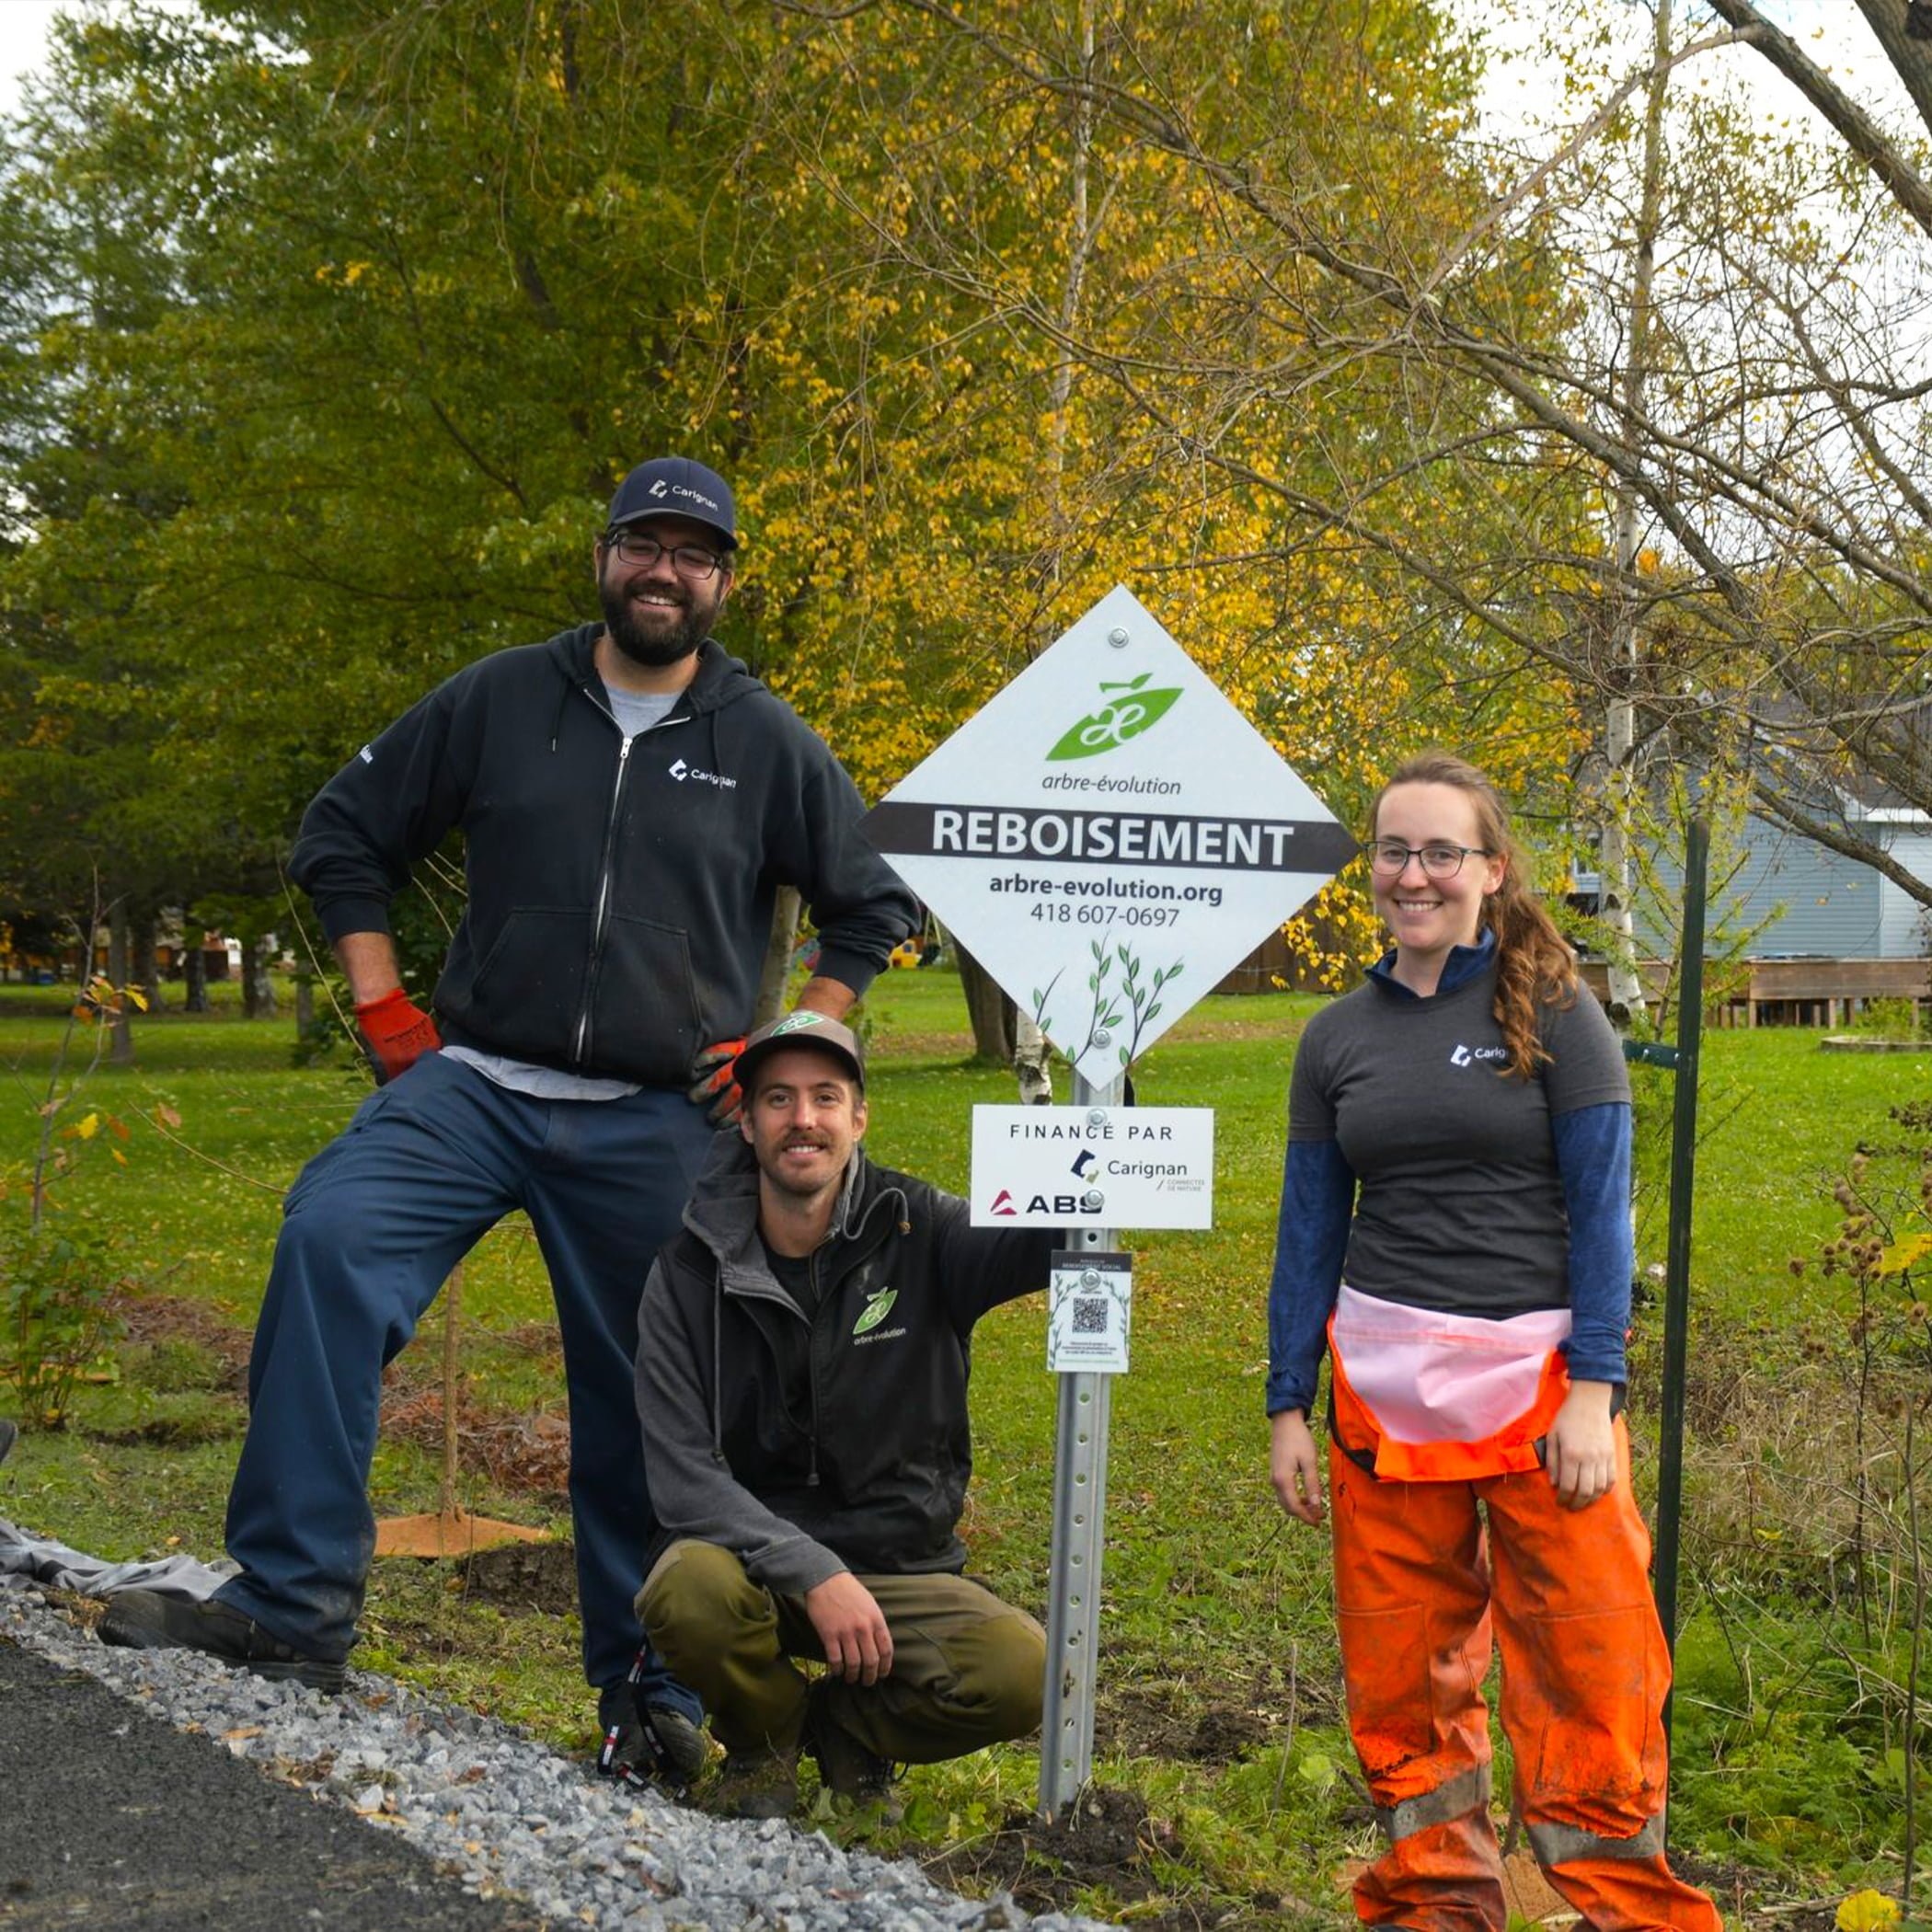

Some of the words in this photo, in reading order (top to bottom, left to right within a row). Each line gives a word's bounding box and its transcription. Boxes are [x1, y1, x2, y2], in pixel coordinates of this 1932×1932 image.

[672, 485, 719, 512] Carignan
[691, 768, 737, 789] Carignan
[1041, 773, 1181, 795] arbre-évolution
[932, 809, 1294, 867] REBOISEMENT
[989, 873, 1223, 907] arbre-evolution.org
[1030, 903, 1071, 923] 418
[1077, 904, 1179, 927] 607-0697
[1474, 1046, 1507, 1059] Carig
[1010, 1122, 1113, 1140] FINANCÉ
[1128, 1126, 1173, 1141] PAR
[1107, 1160, 1188, 1179] Carignan
